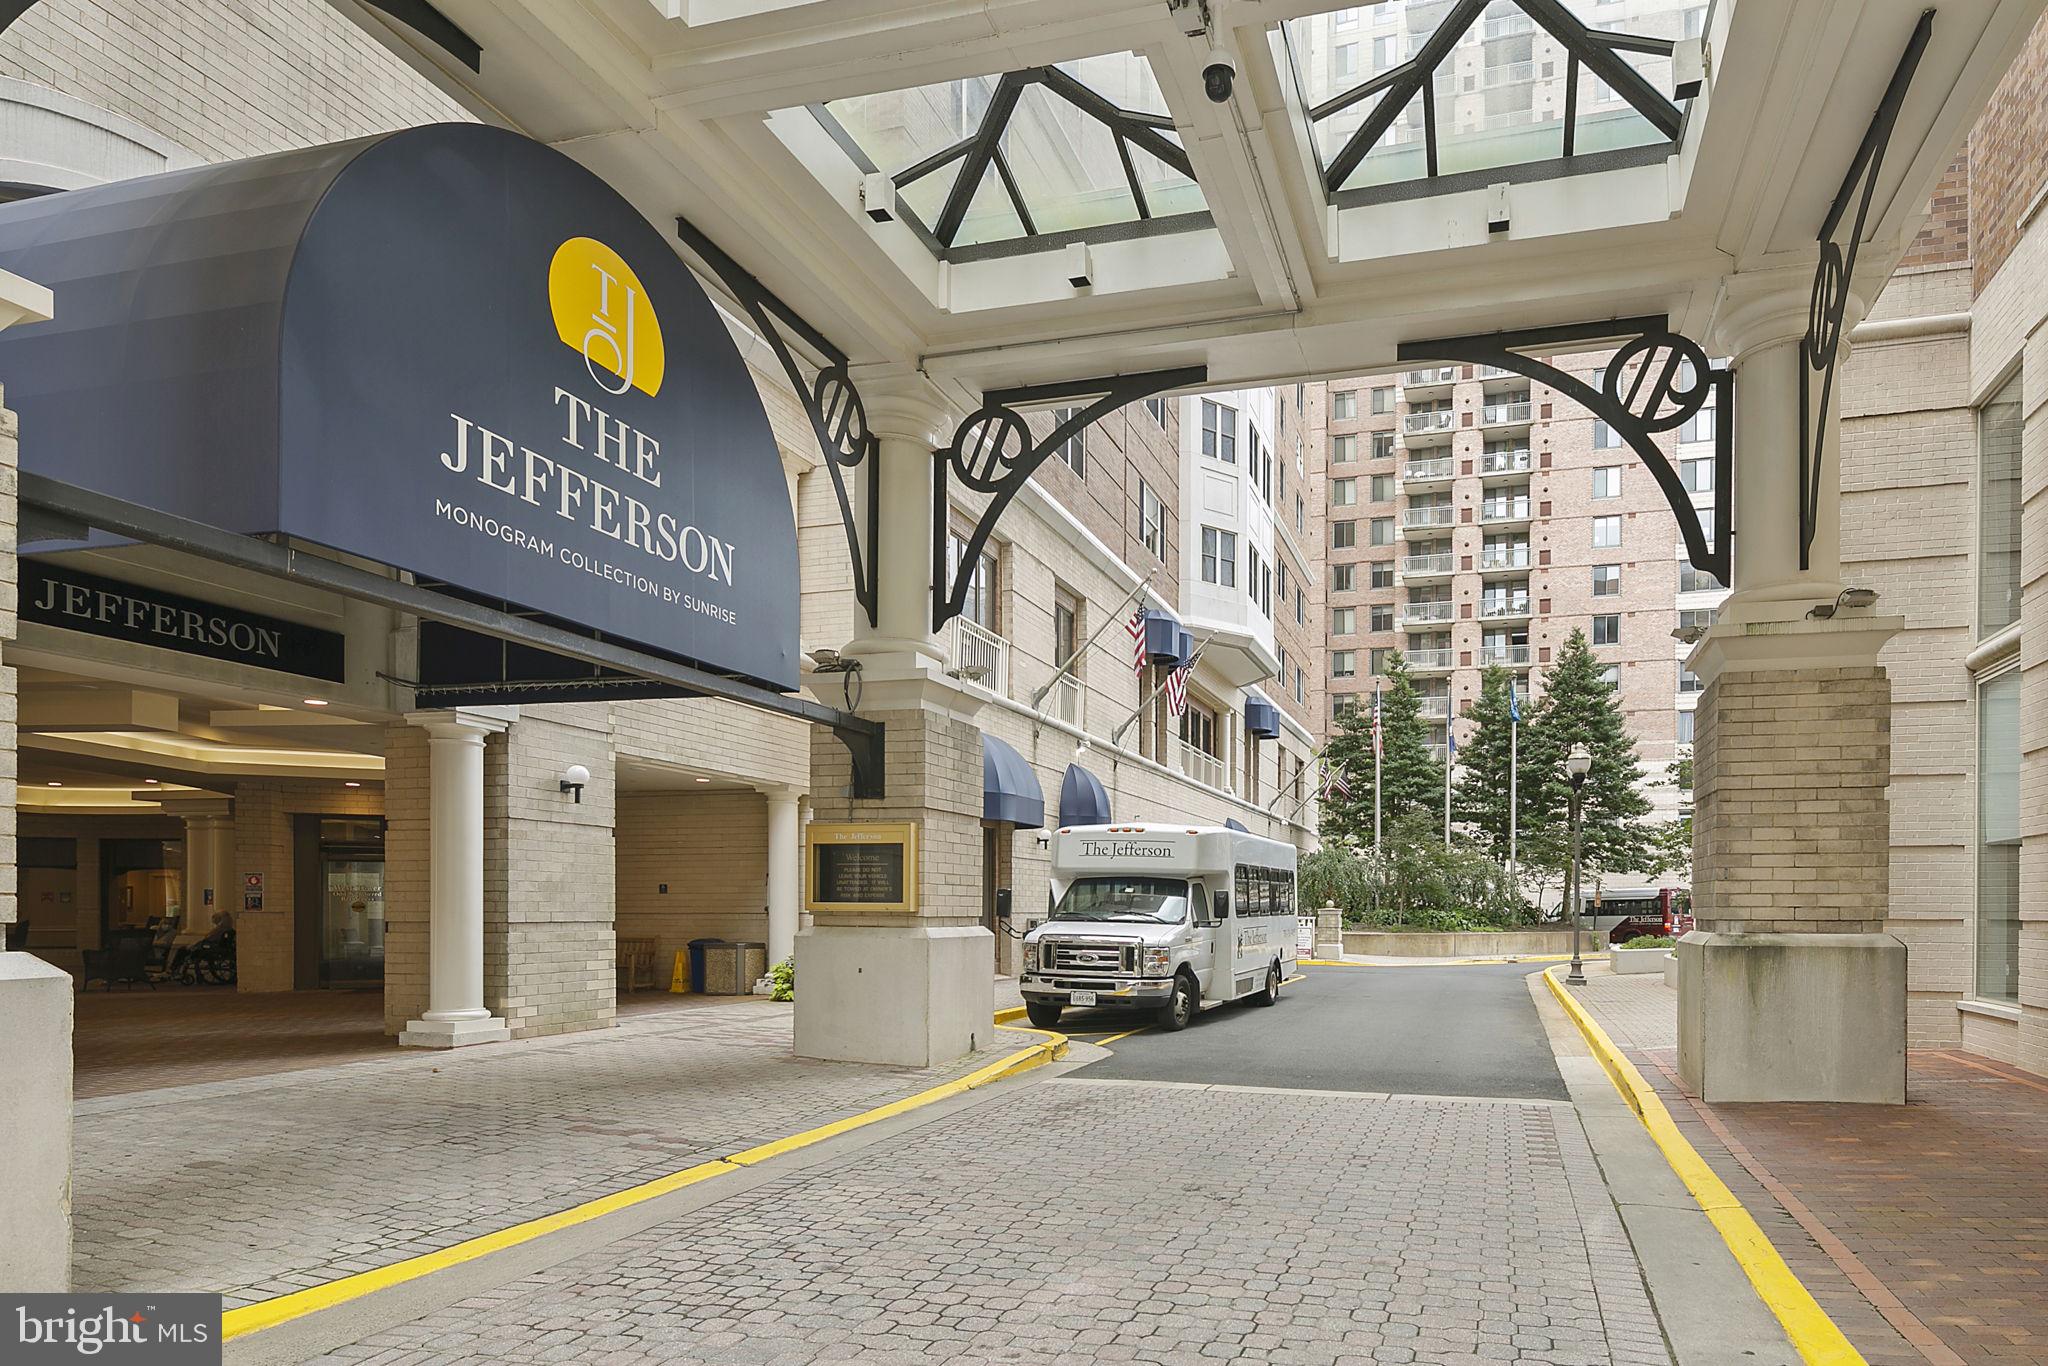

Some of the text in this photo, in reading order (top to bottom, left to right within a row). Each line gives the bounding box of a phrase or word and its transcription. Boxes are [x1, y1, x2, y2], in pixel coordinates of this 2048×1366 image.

[554, 386, 661, 488] THE
[440, 413, 736, 587] JEFFERSON
[436, 499, 736, 626] MONOGRAM COLLECTION BY SUNRISE
[34, 578, 283, 658] JEFFERSON
[834, 832, 847, 840] The
[845, 853, 880, 862] Welcome
[1082, 841, 1171, 859] The Jefferson
